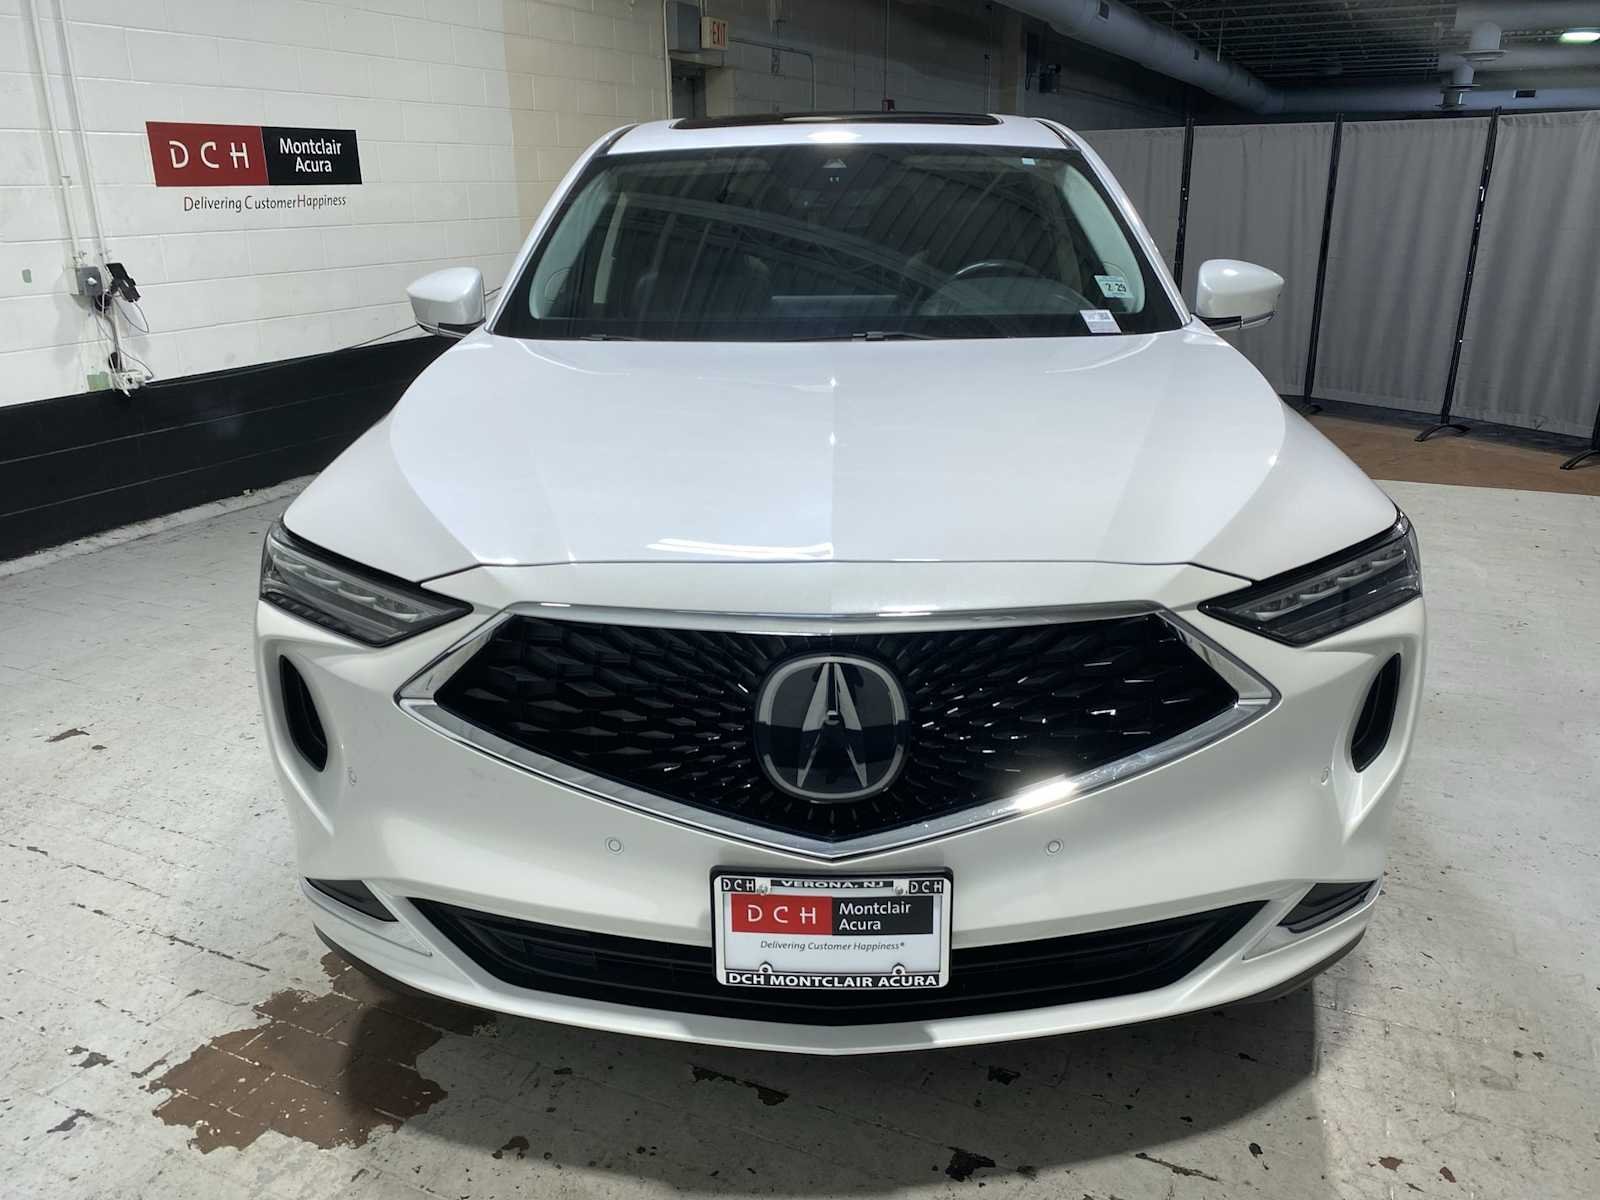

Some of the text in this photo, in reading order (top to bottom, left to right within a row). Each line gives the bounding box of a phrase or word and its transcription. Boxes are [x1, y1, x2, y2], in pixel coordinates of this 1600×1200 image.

[712, 20, 727, 47] EXIT
[279, 137, 342, 155] Montclair
[295, 157, 333, 173] Acura
[183, 195, 242, 213] Delivering
[863, 880, 884, 889] NJ
[839, 901, 912, 916] Montclair
[838, 917, 882, 931] Acura
[760, 940, 806, 952] Delivering
[807, 941, 852, 952] Customer
[728, 973, 938, 988] DCH MONTCLAIR ACURA
